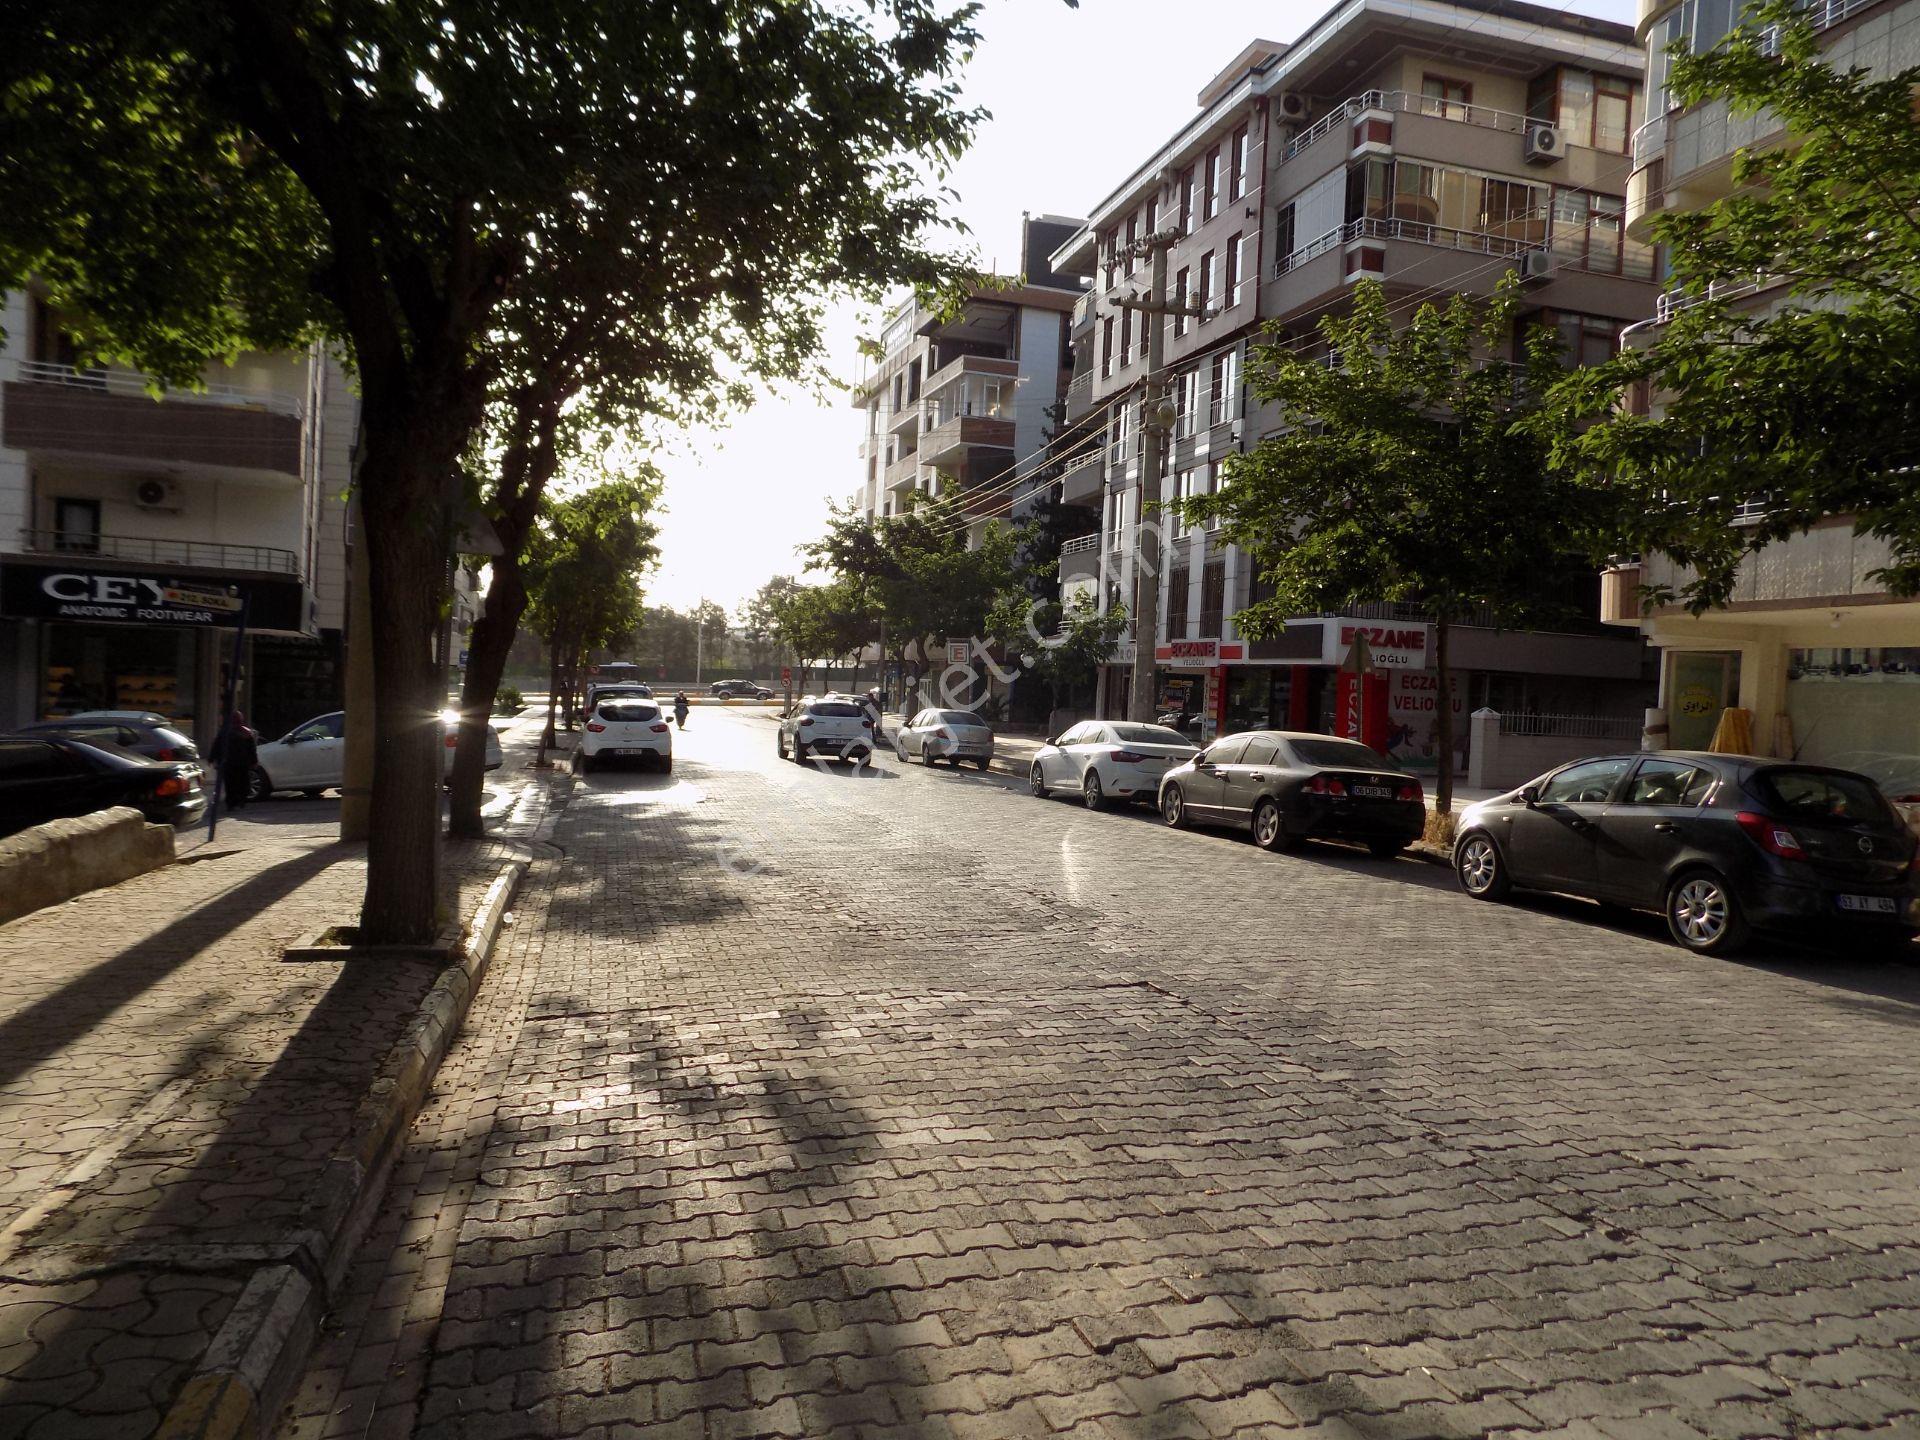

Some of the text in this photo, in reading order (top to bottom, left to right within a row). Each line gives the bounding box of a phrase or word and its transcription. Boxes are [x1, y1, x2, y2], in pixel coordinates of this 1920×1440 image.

[59, 605, 213, 622] ANATOMIC FOOTWEAR
[953, 647, 965, 660] E
[1171, 642, 1216, 657] ECZANE
[1402, 675, 1457, 692] ECZAE
[1348, 678, 1358, 740] ECZA
